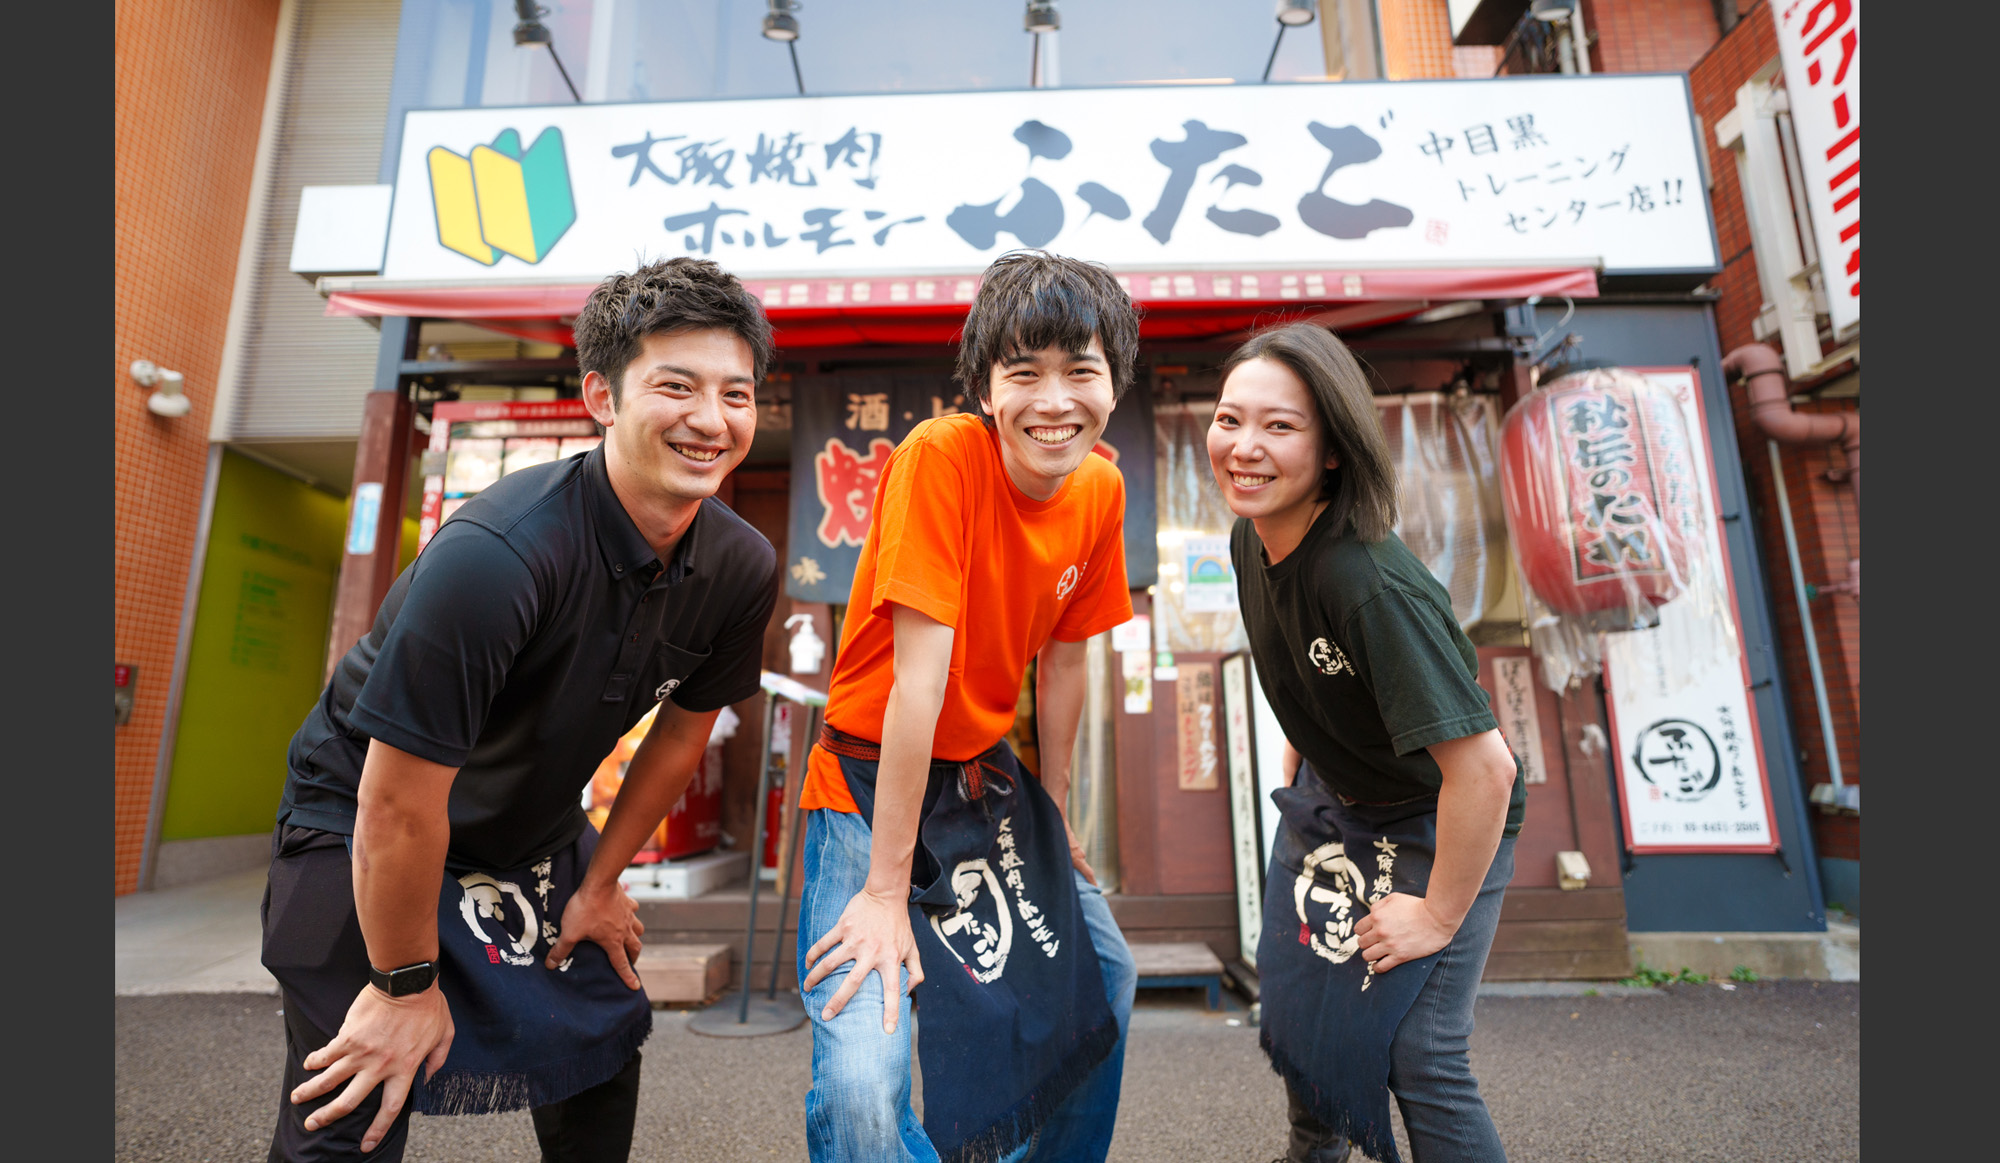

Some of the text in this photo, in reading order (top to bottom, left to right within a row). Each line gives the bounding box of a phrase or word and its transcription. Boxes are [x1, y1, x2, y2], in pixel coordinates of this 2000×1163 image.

[611, 127, 883, 190] 大阪焼肉
[1419, 113, 1549, 165] 中目黒
[946, 109, 1415, 251] ふたご
[1457, 143, 1631, 202] トレーニング
[664, 200, 926, 255] ホルモン
[1564, 394, 1651, 564] 秘伝のたれ
